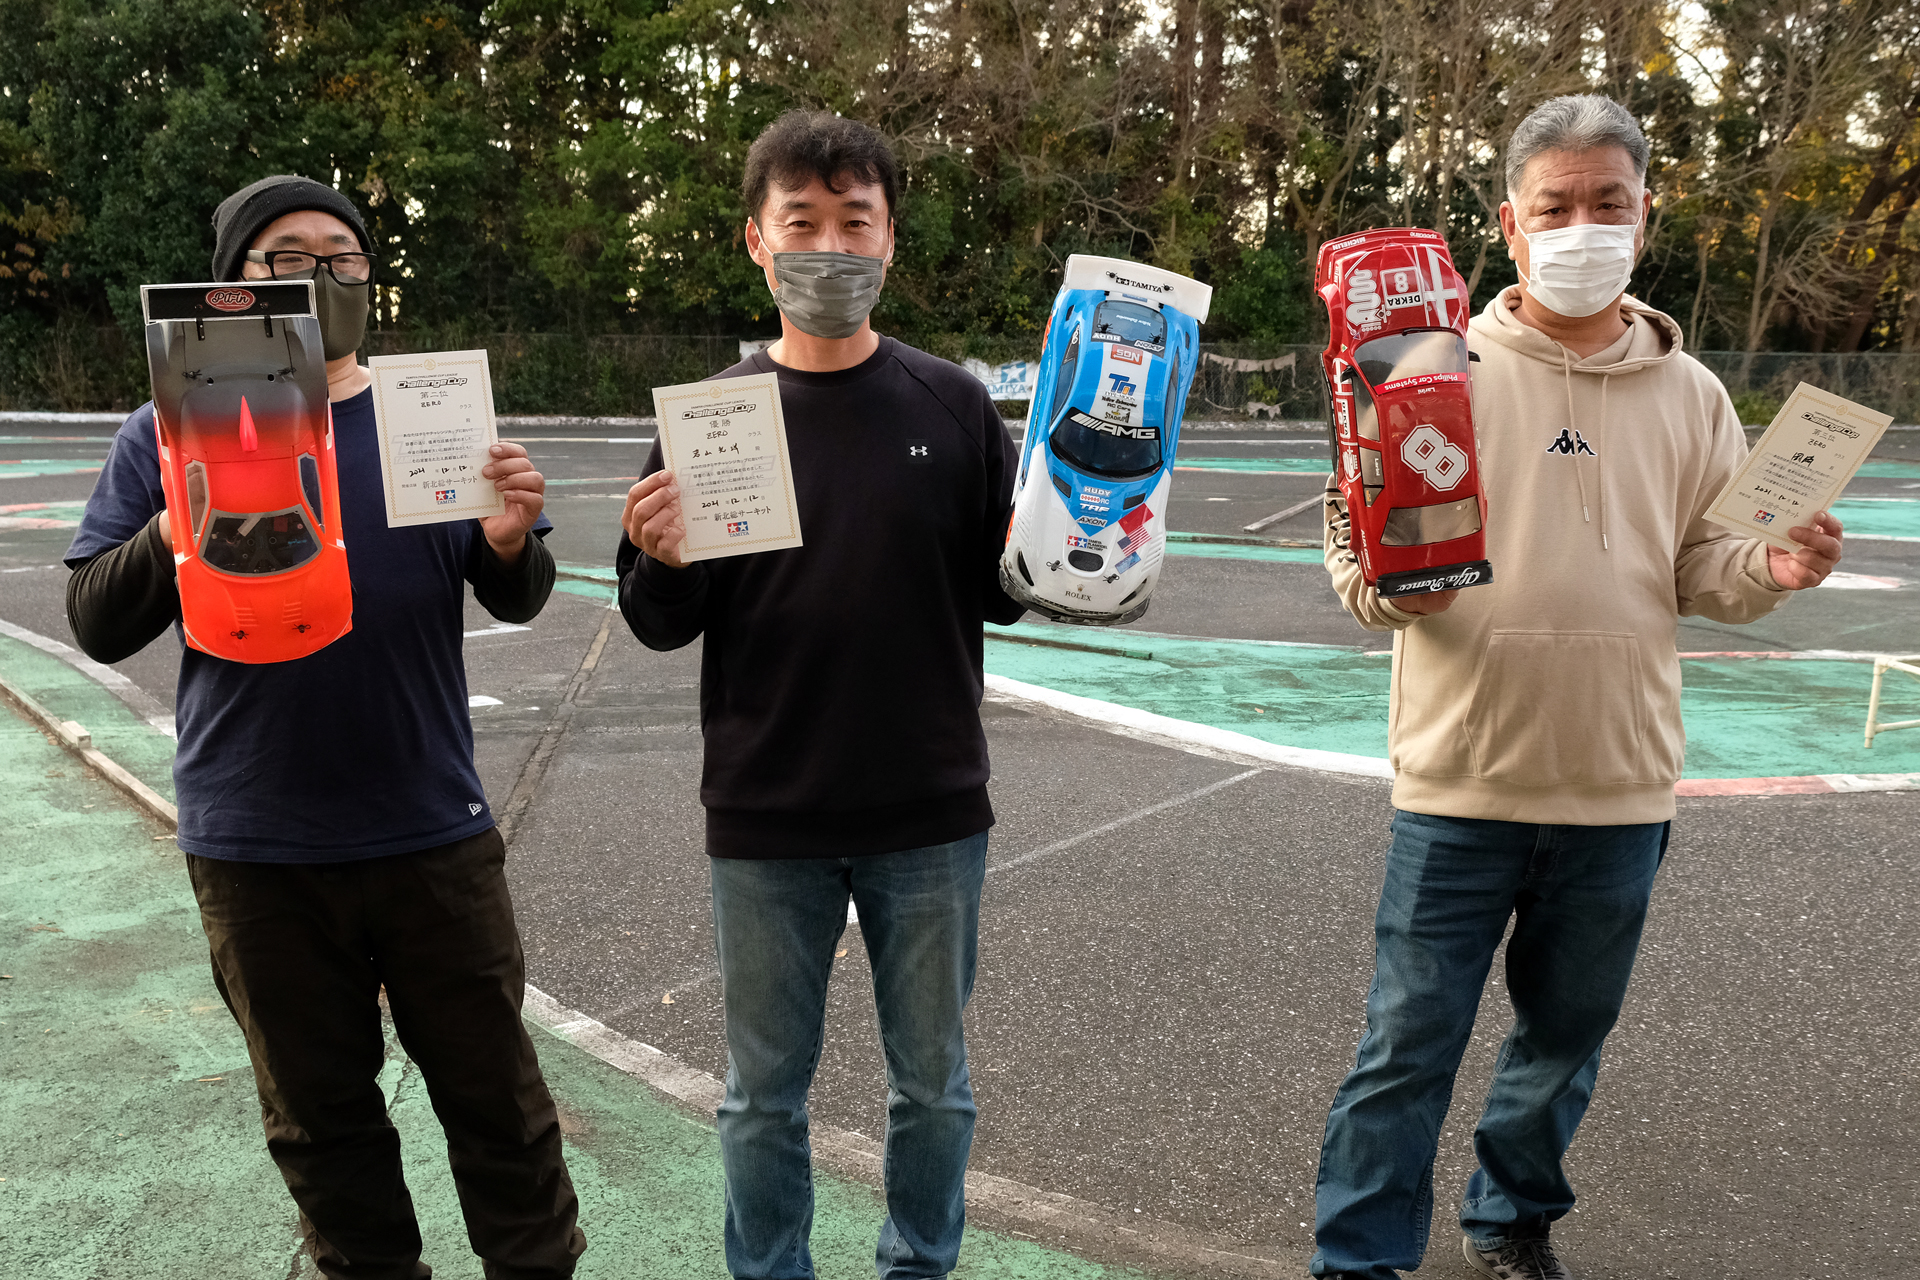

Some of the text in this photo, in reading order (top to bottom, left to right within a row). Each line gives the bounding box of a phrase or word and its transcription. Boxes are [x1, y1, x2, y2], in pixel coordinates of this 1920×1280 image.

[1332, 237, 1366, 250] MICHELIN
[1130, 281, 1162, 293] TAMIYA
[1394, 272, 1410, 293] 8
[1387, 294, 1420, 306] DEKRA
[1092, 332, 1122, 342] HUDY
[1134, 340, 1165, 352] AXON
[1116, 348, 1140, 362] NOS
[396, 377, 468, 389] Challenge Cup
[986, 384, 1026, 394] AMIYA
[1384, 379, 1418, 390] Systems
[420, 390, 448, 399] 第二位
[682, 404, 756, 420] Challenge Cup
[709, 419, 731, 428] 優勝
[1801, 412, 1843, 432] Challenge
[1842, 428, 1860, 439] Cup
[706, 430, 728, 439] ZERO
[1095, 422, 1155, 439] AMG
[1812, 429, 1836, 442] 第三位
[1808, 439, 1826, 449] ZERO
[1400, 424, 1469, 492] 8
[1084, 486, 1112, 496] HUDY
[1078, 516, 1107, 527] AXON
[1396, 578, 1444, 591] Romeo
[1065, 591, 1092, 601] ROLEX
